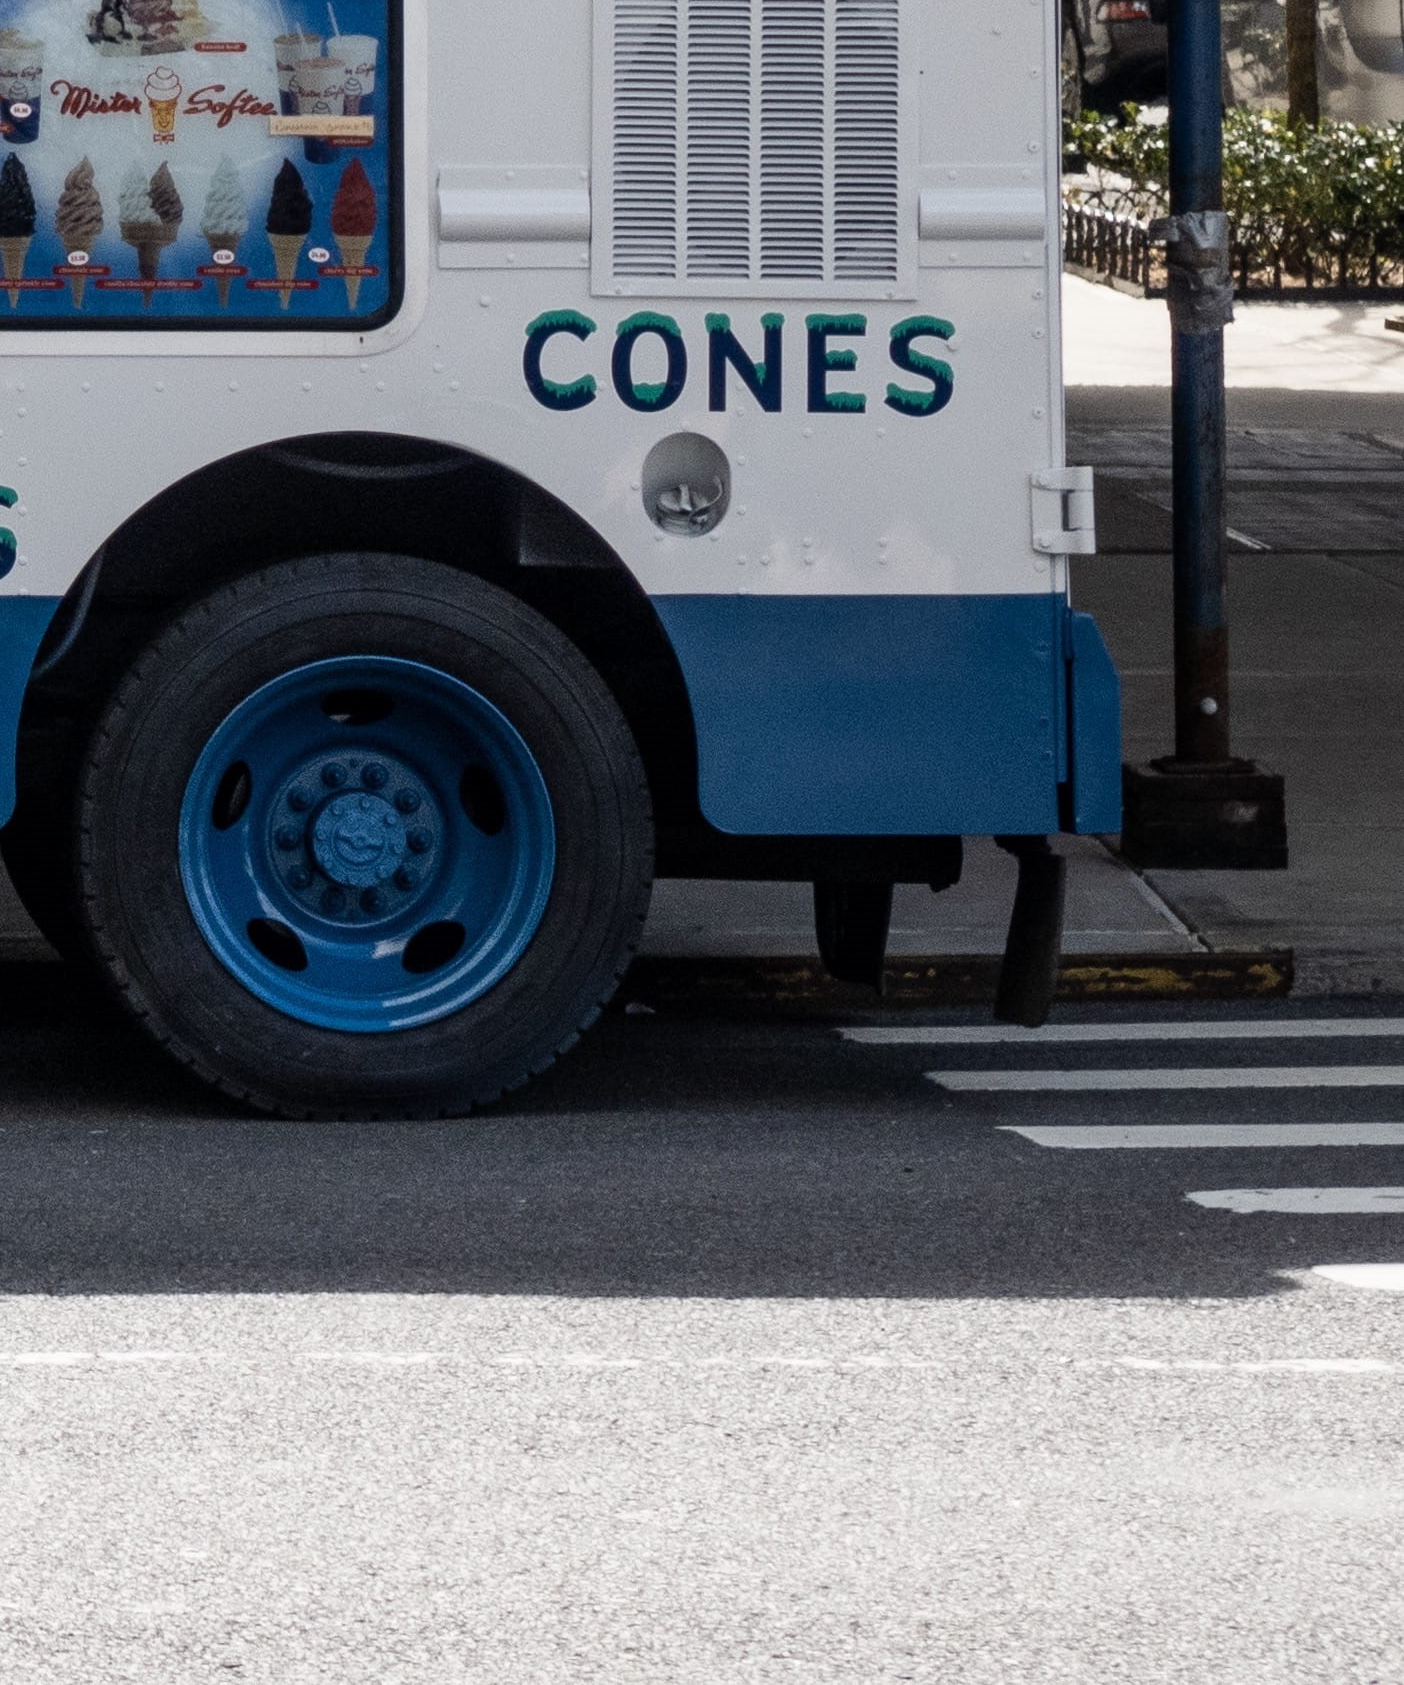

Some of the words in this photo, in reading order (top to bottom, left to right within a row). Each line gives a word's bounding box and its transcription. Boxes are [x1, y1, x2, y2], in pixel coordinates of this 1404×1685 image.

[50, 80, 143, 119] Mister
[183, 84, 279, 129] Softee
[523, 309, 956, 417] CONES
